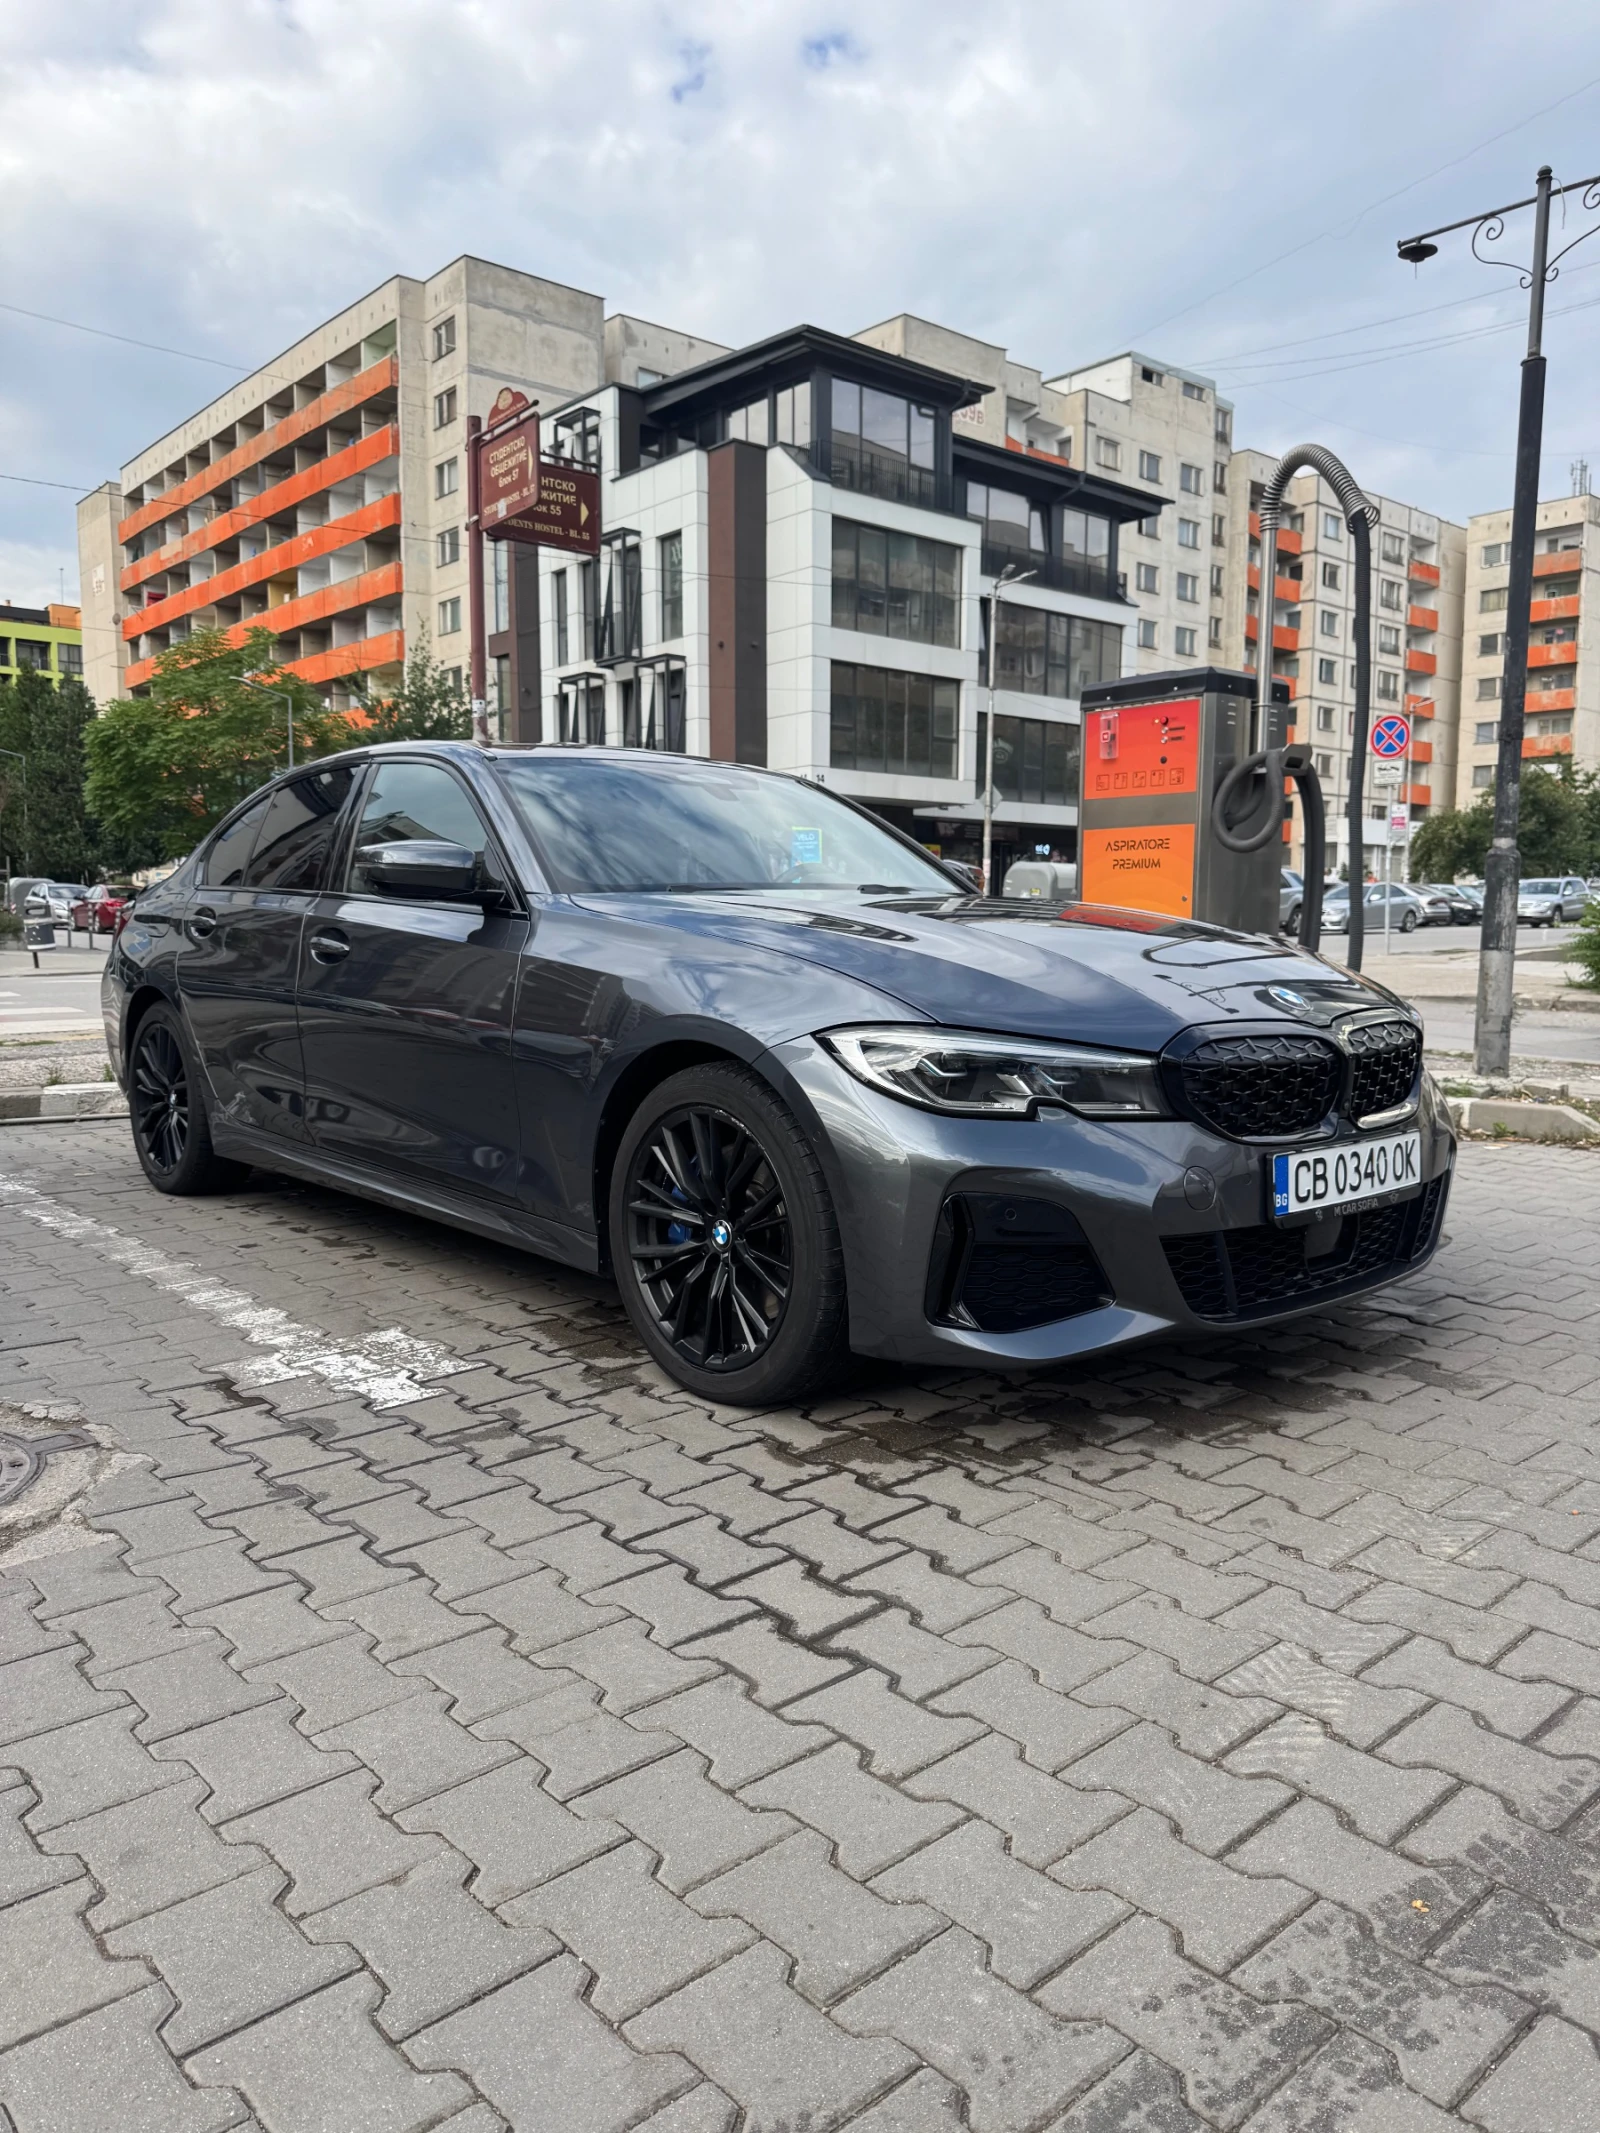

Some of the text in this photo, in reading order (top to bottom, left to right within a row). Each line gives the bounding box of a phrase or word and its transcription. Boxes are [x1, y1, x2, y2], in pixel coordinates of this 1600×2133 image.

[541, 476, 577, 493] НТСКО
[540, 489, 577, 507] ЖИТИЕ
[550, 504, 562, 516] 55
[534, 522, 565, 536] HOSTEL
[1105, 838, 1171, 852] ASPIRATORE
[1112, 858, 1161, 870] PREMIUM
[1294, 1138, 1417, 1203] CB 0340 OK
[1275, 1193, 1288, 1208] BG
